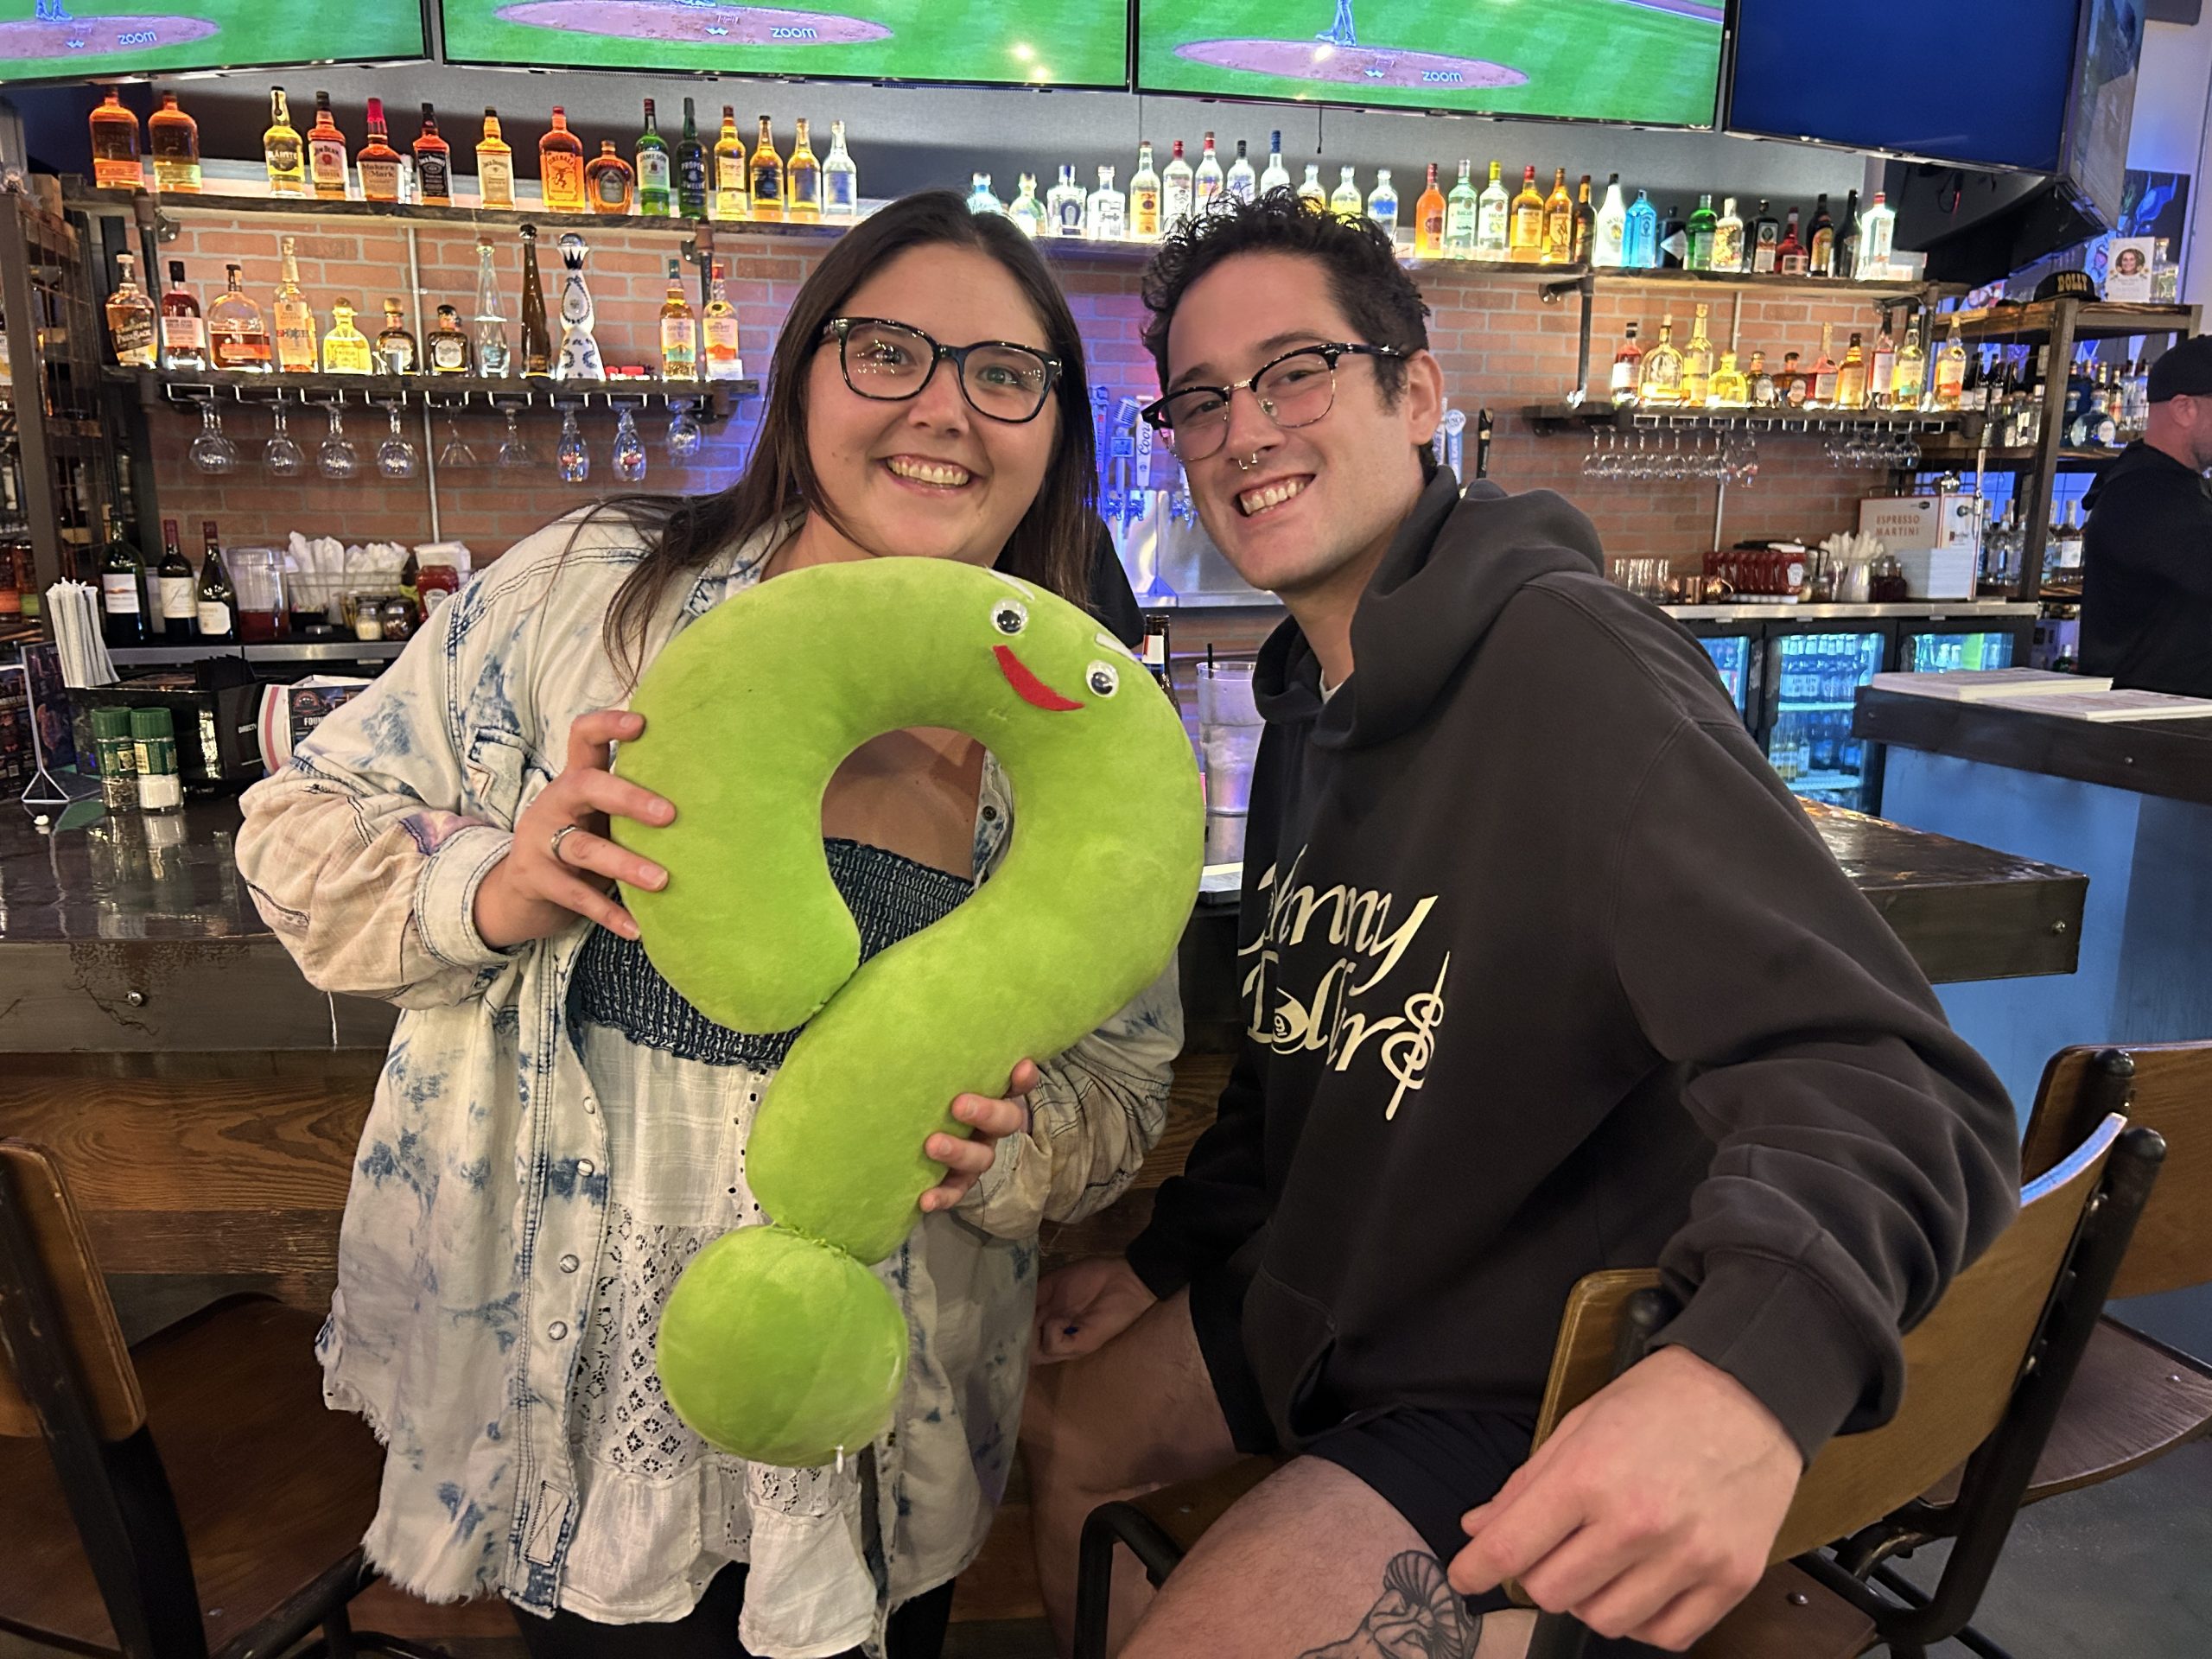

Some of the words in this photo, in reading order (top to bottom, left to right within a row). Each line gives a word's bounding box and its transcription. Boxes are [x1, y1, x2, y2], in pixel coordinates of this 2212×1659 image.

[118, 31, 157, 45] zoom
[770, 27, 818, 39] zoom
[1421, 70, 1463, 82] zoom
[2056, 275, 2088, 293] DOLLY
[1876, 514, 1921, 525] ESPRESSO
[1876, 526, 1920, 537] MARTINI
